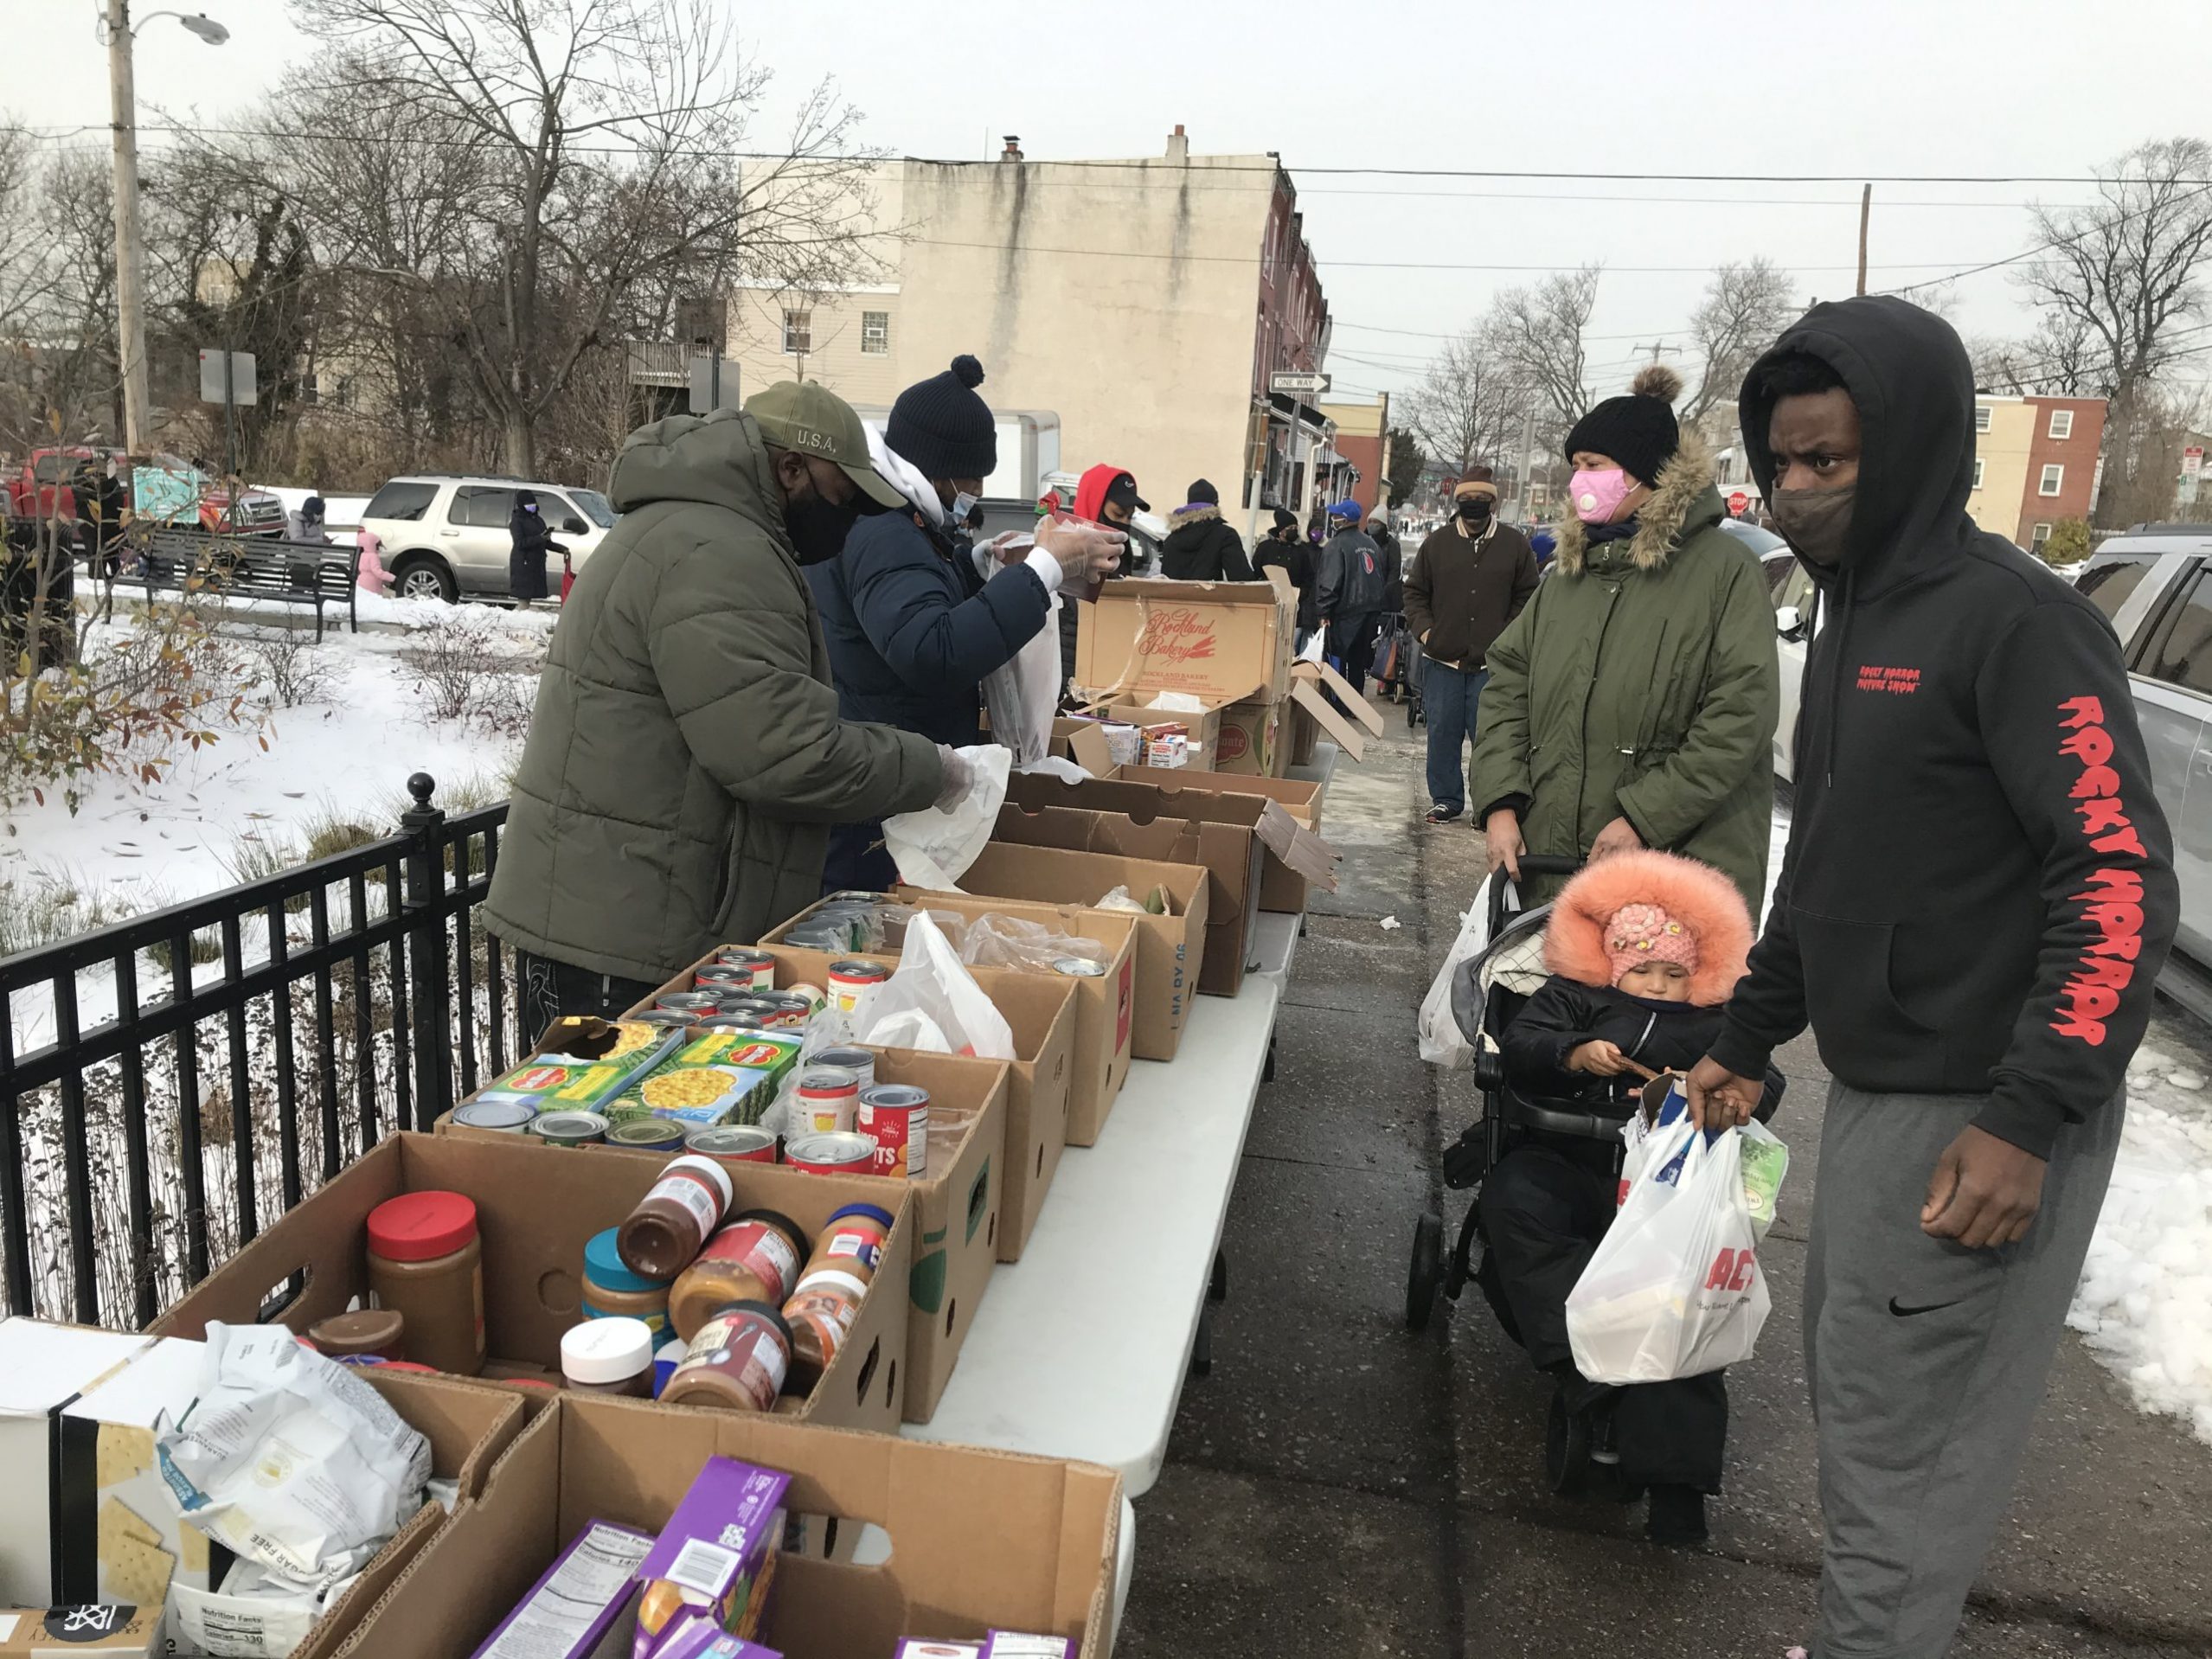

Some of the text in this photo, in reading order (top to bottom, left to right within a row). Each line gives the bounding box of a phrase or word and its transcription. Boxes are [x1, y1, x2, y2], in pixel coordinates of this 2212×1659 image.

[1277, 378, 1313, 388] ONE WAY
[798, 430, 837, 453] U.S.A.
[1729, 497, 1747, 506] STOP
[1145, 608, 1215, 637] Rockland
[1138, 635, 1192, 663] Bakery
[2049, 695, 2148, 1047] ROCKY HORROR
[593, 1526, 629, 1540] Nutrition
[250, 1534, 277, 1558] FREE
[202, 1607, 235, 1621] Nutrition
